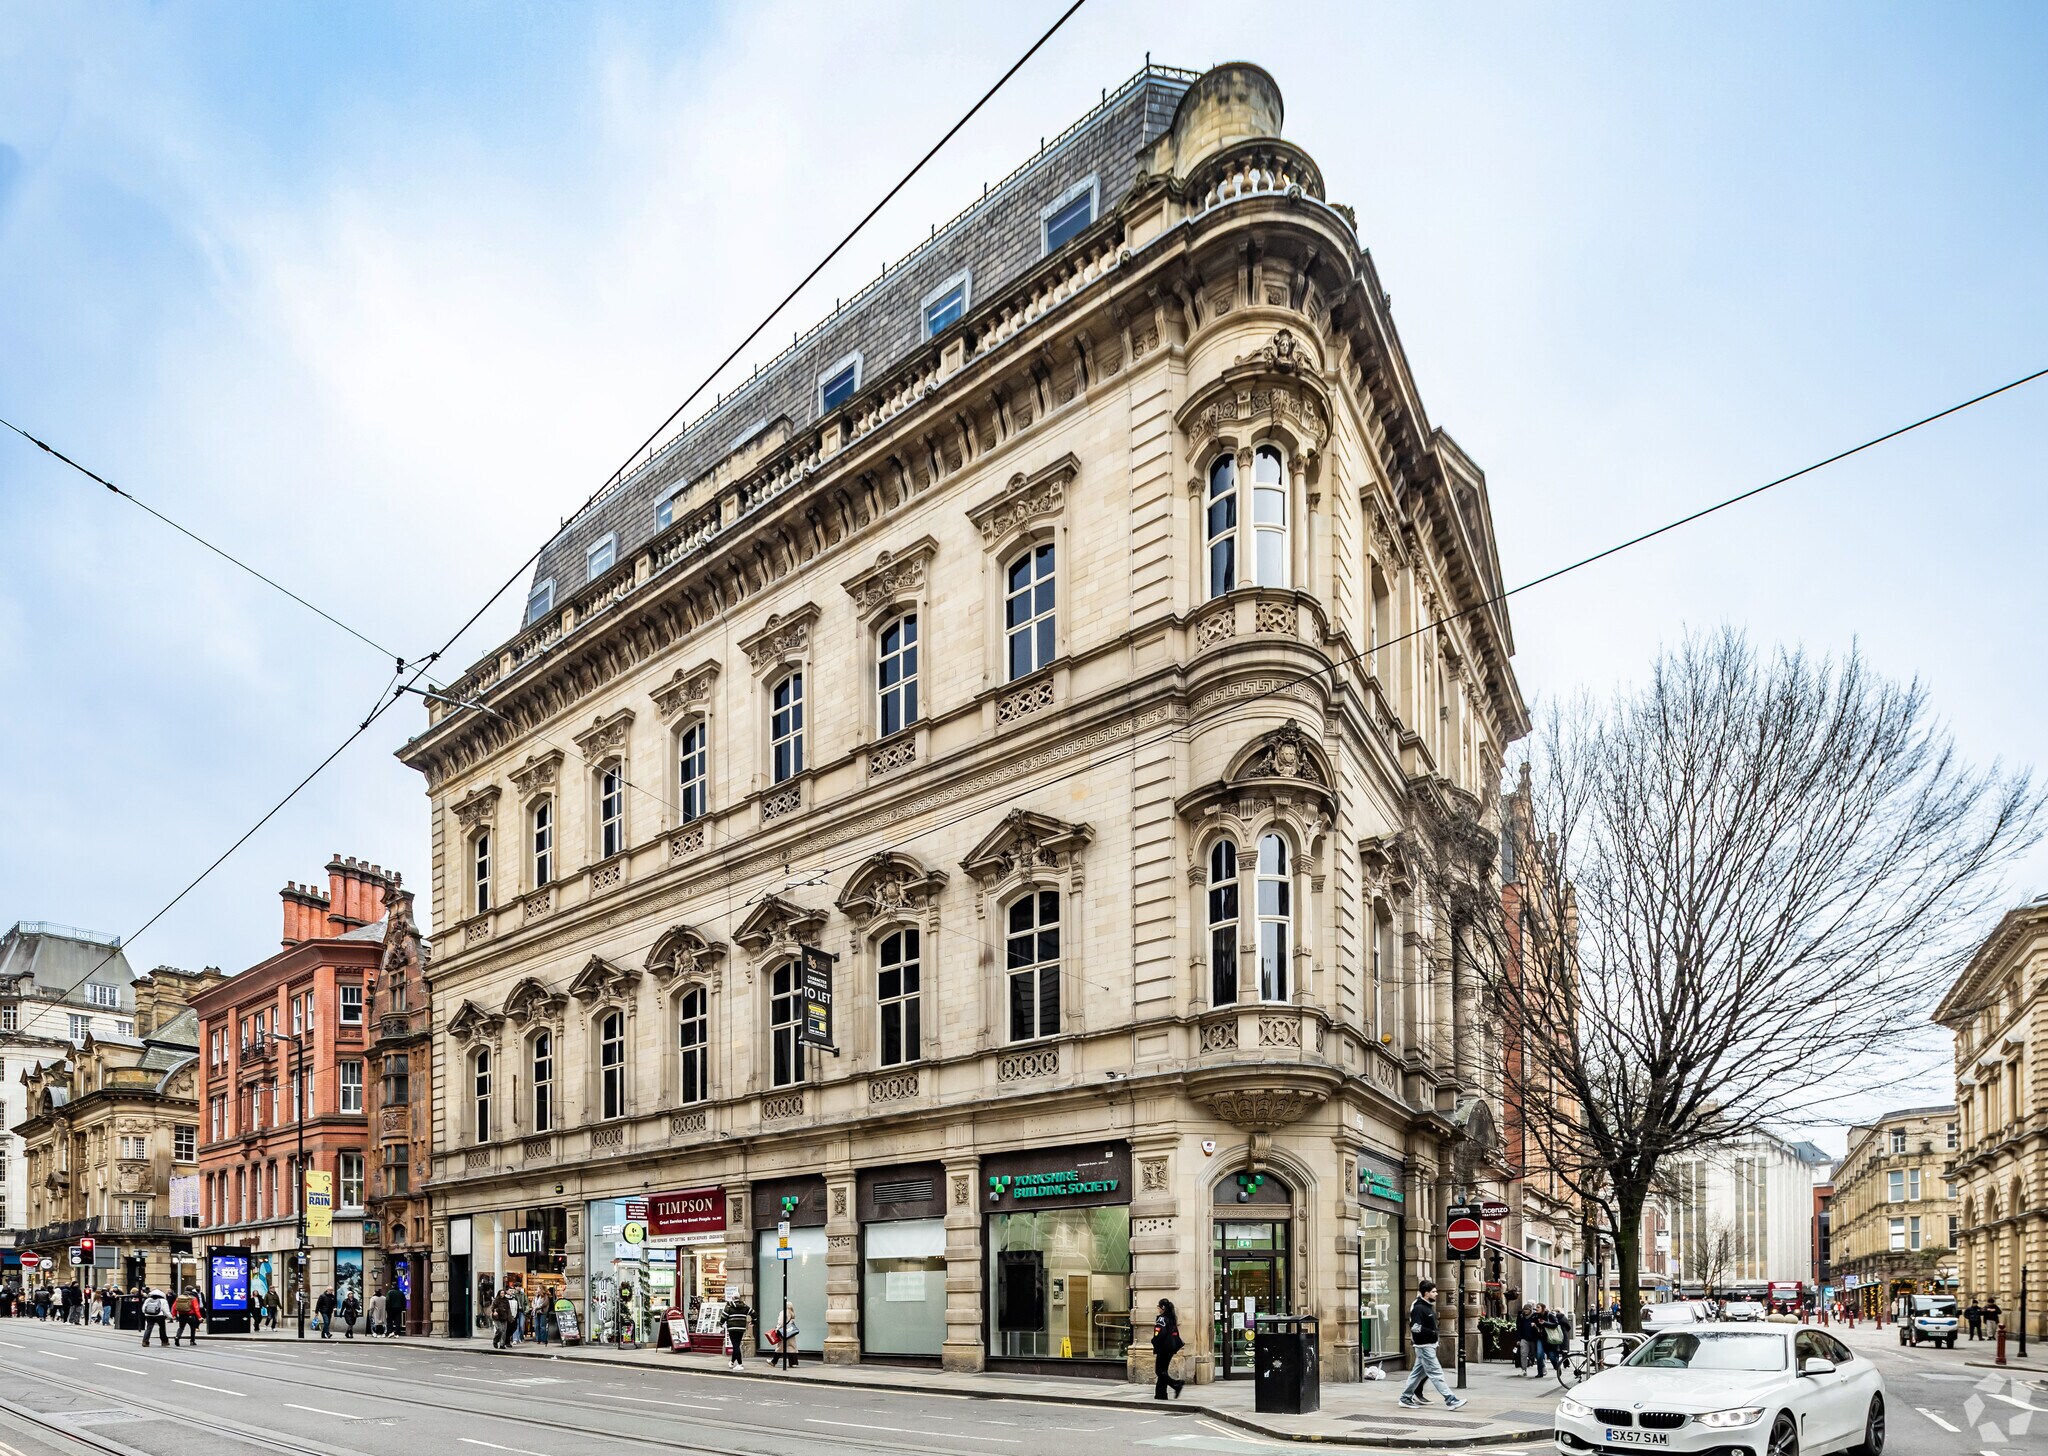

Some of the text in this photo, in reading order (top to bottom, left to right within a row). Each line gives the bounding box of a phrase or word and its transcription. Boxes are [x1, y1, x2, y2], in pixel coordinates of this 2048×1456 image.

[803, 986, 831, 1004] TO LET
[1014, 1170, 1079, 1186] YORKSHIRE
[1013, 1179, 1119, 1199] BUILDING SOCIETY
[309, 1196, 330, 1206] RAIN
[657, 1198, 713, 1216] TIMPSON
[509, 1230, 543, 1254] UTILITY
[1612, 1430, 1667, 1444] SX57 SAM
